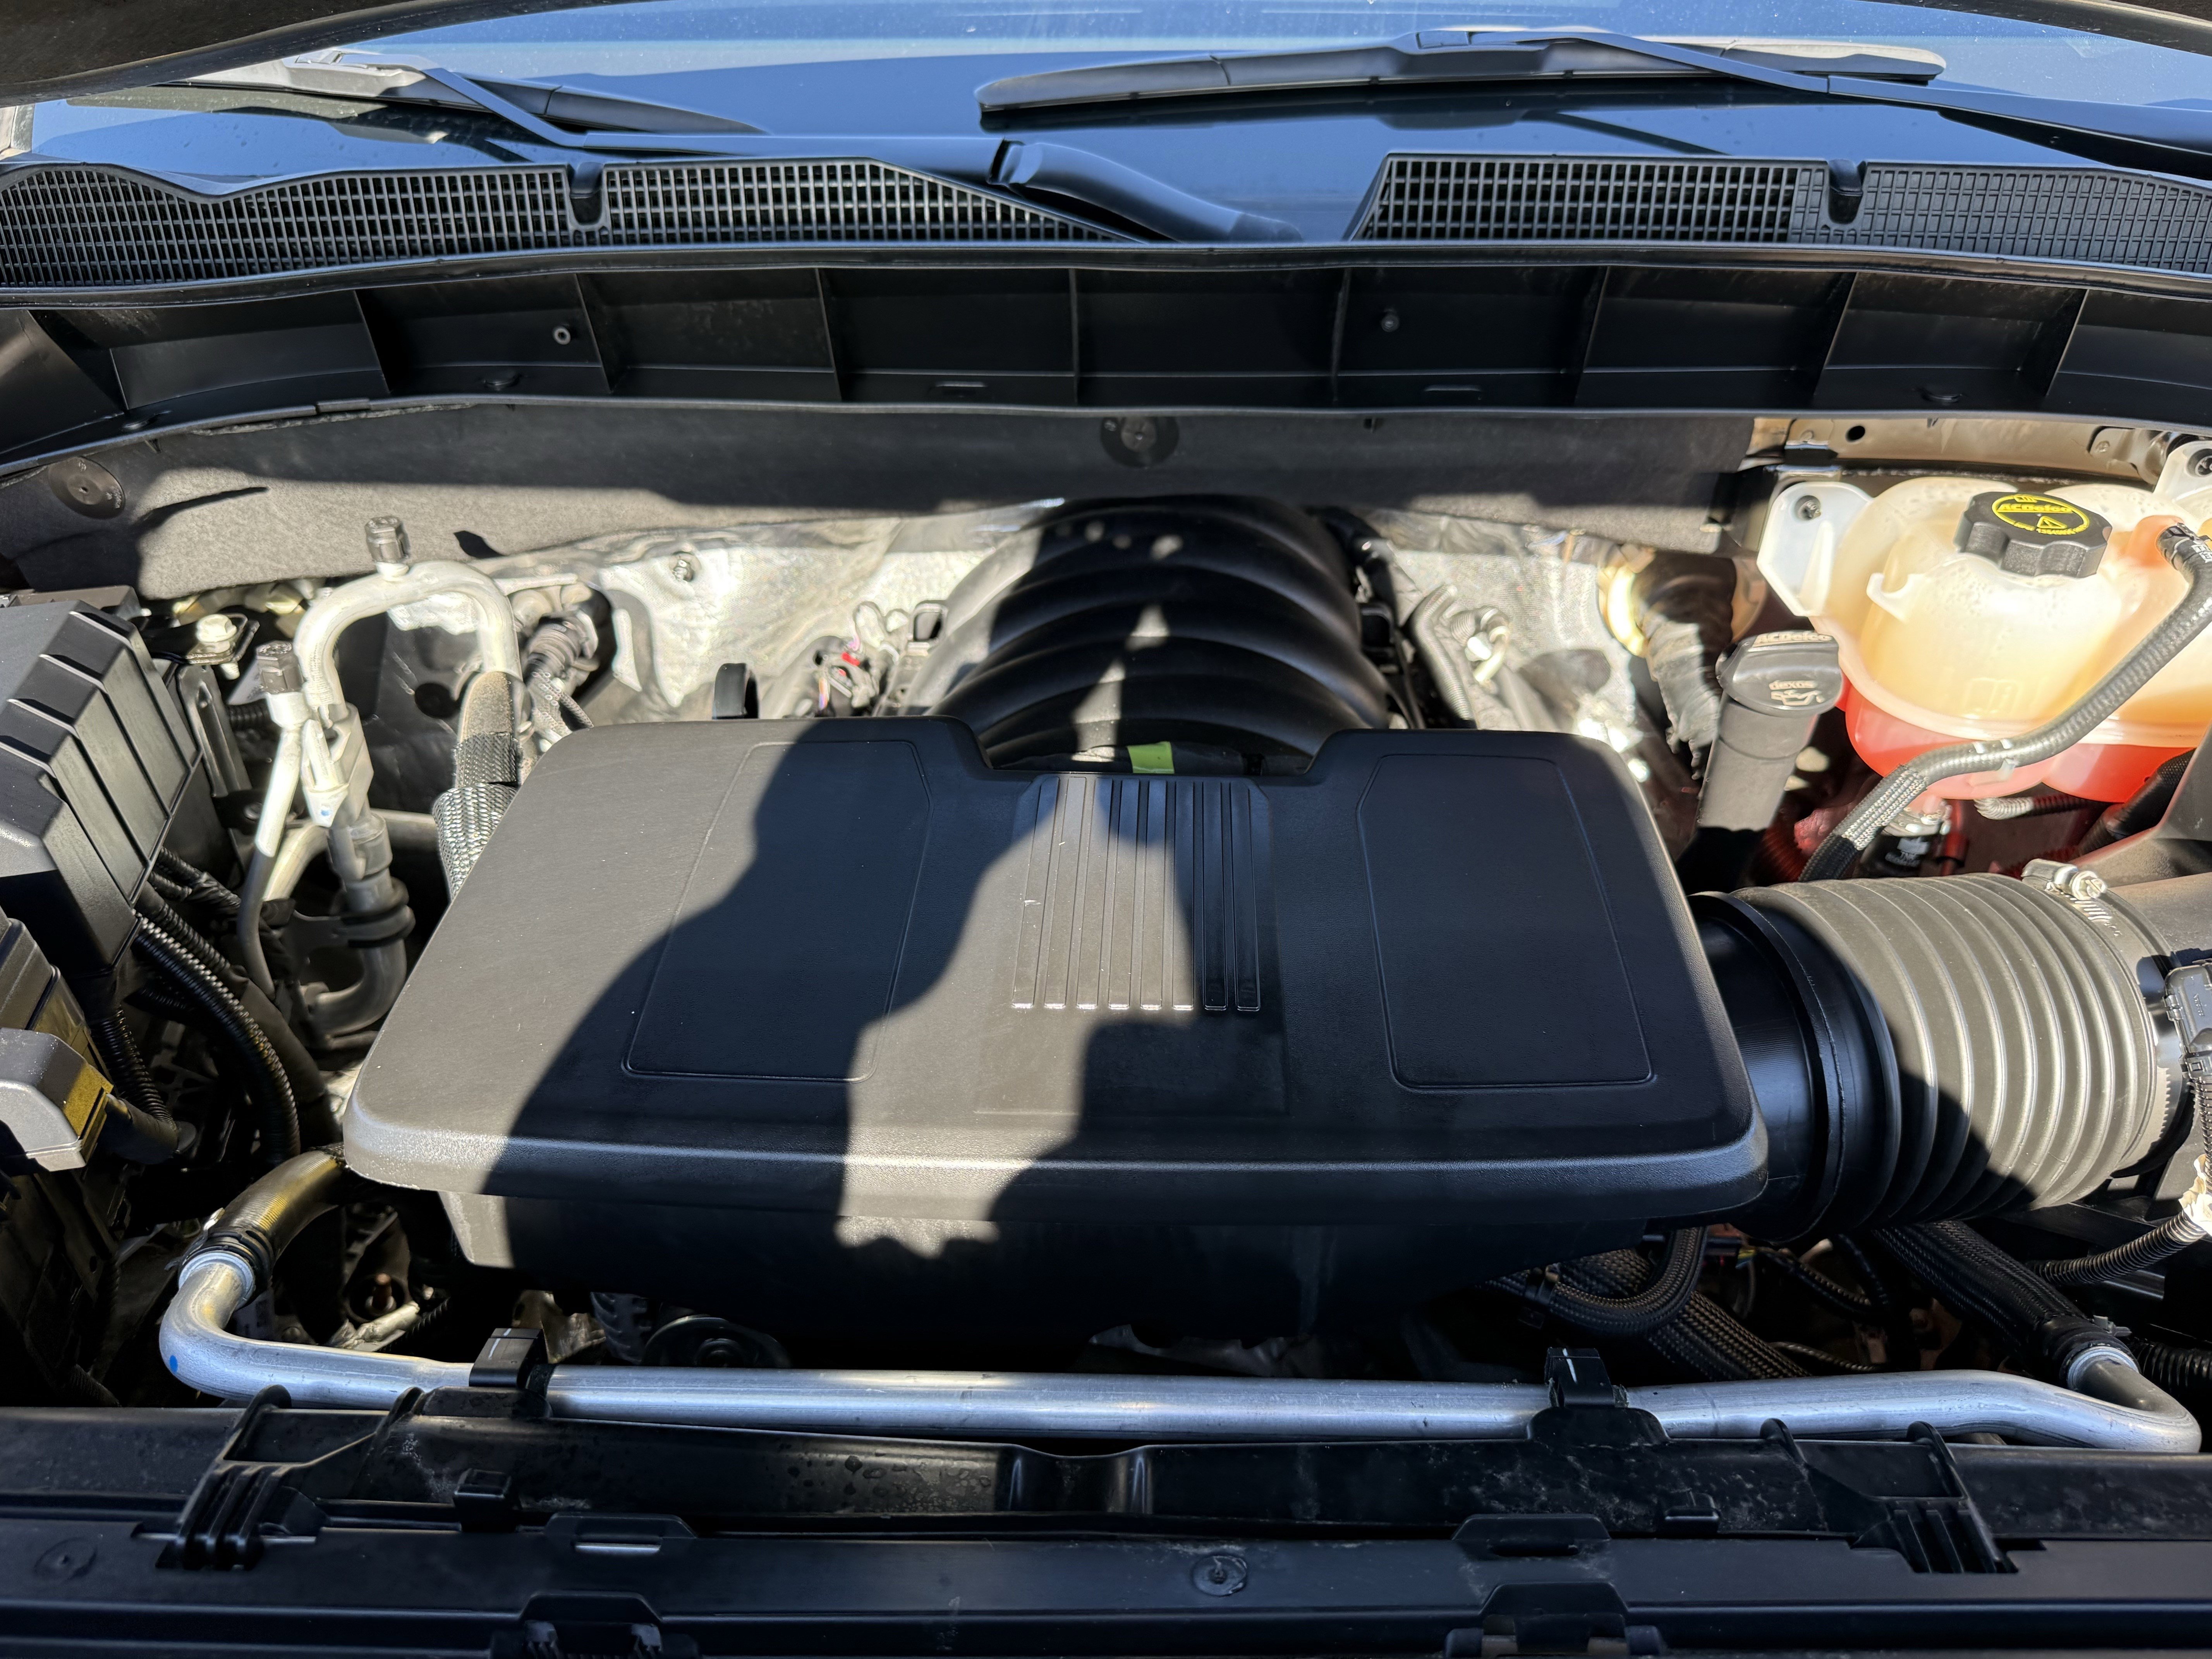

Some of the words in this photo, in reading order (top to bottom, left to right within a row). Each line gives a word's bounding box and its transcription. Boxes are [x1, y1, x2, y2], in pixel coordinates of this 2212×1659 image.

[1997, 503, 2073, 513] ACDelco
[1753, 630, 1834, 646] ACDelco
[1769, 680, 1818, 690] dexos
